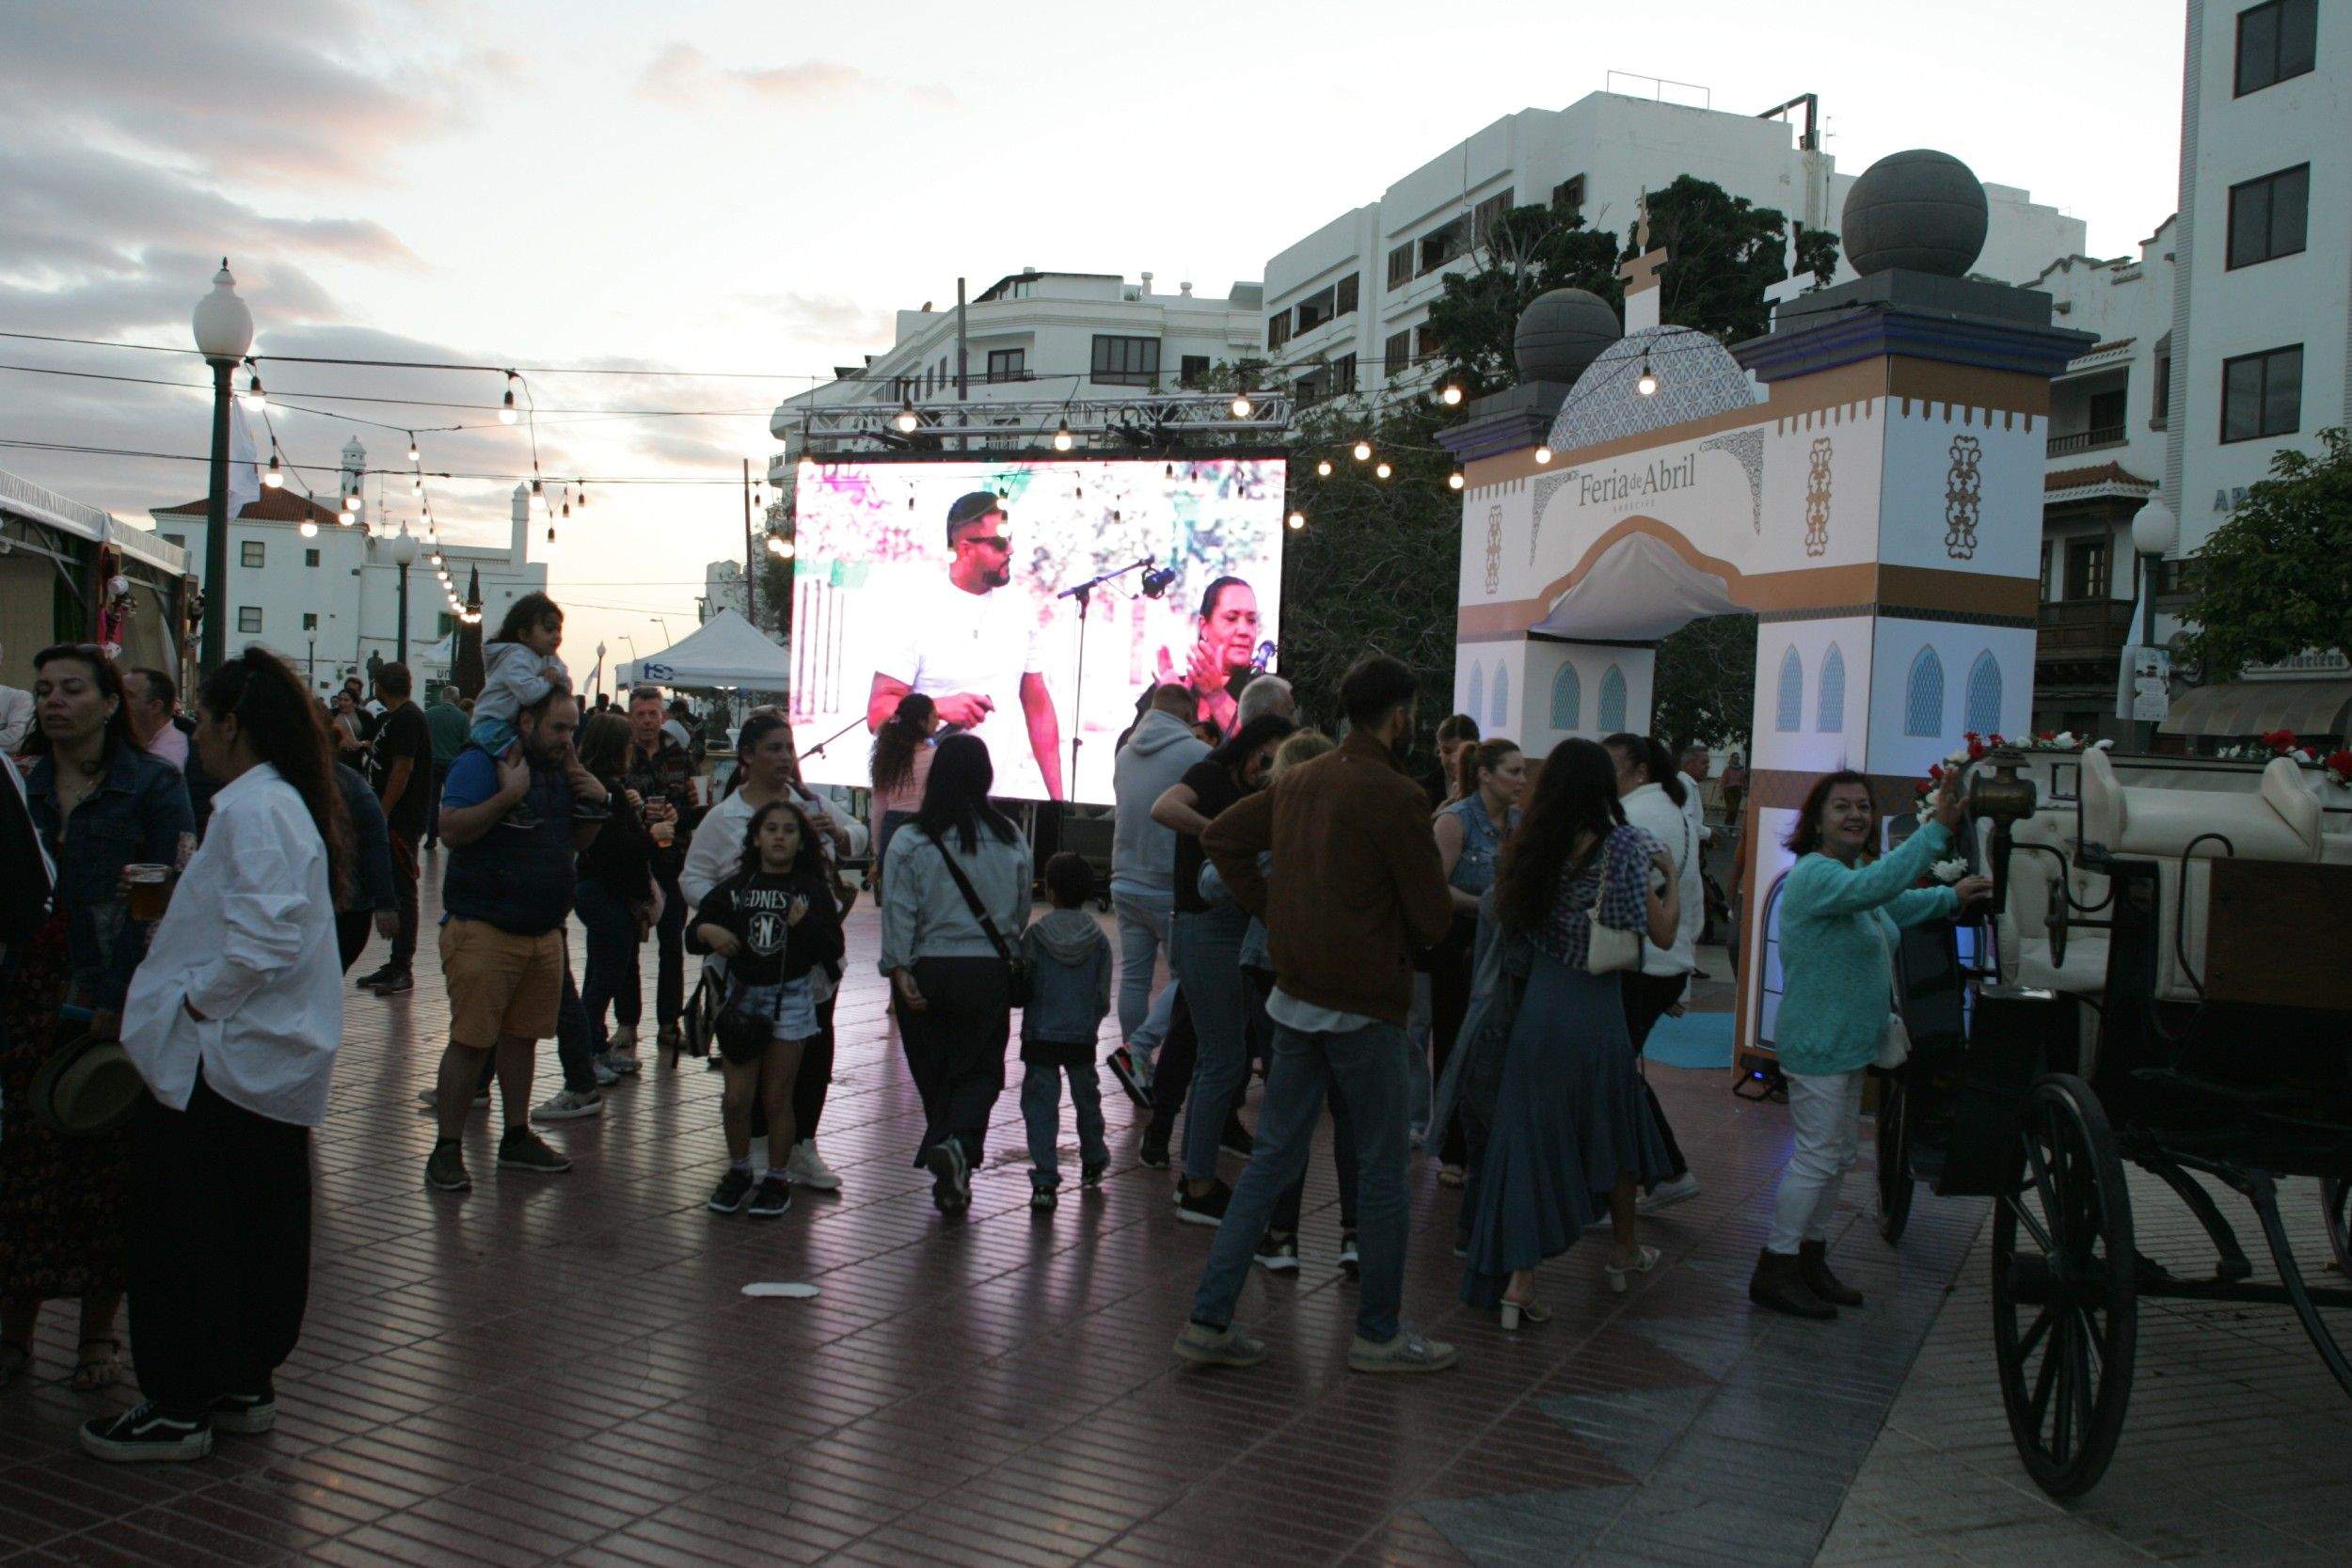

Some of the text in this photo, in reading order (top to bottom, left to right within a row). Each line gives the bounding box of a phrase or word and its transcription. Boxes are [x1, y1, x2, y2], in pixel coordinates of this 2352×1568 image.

[1579, 452, 1695, 506] Feria de Abril
